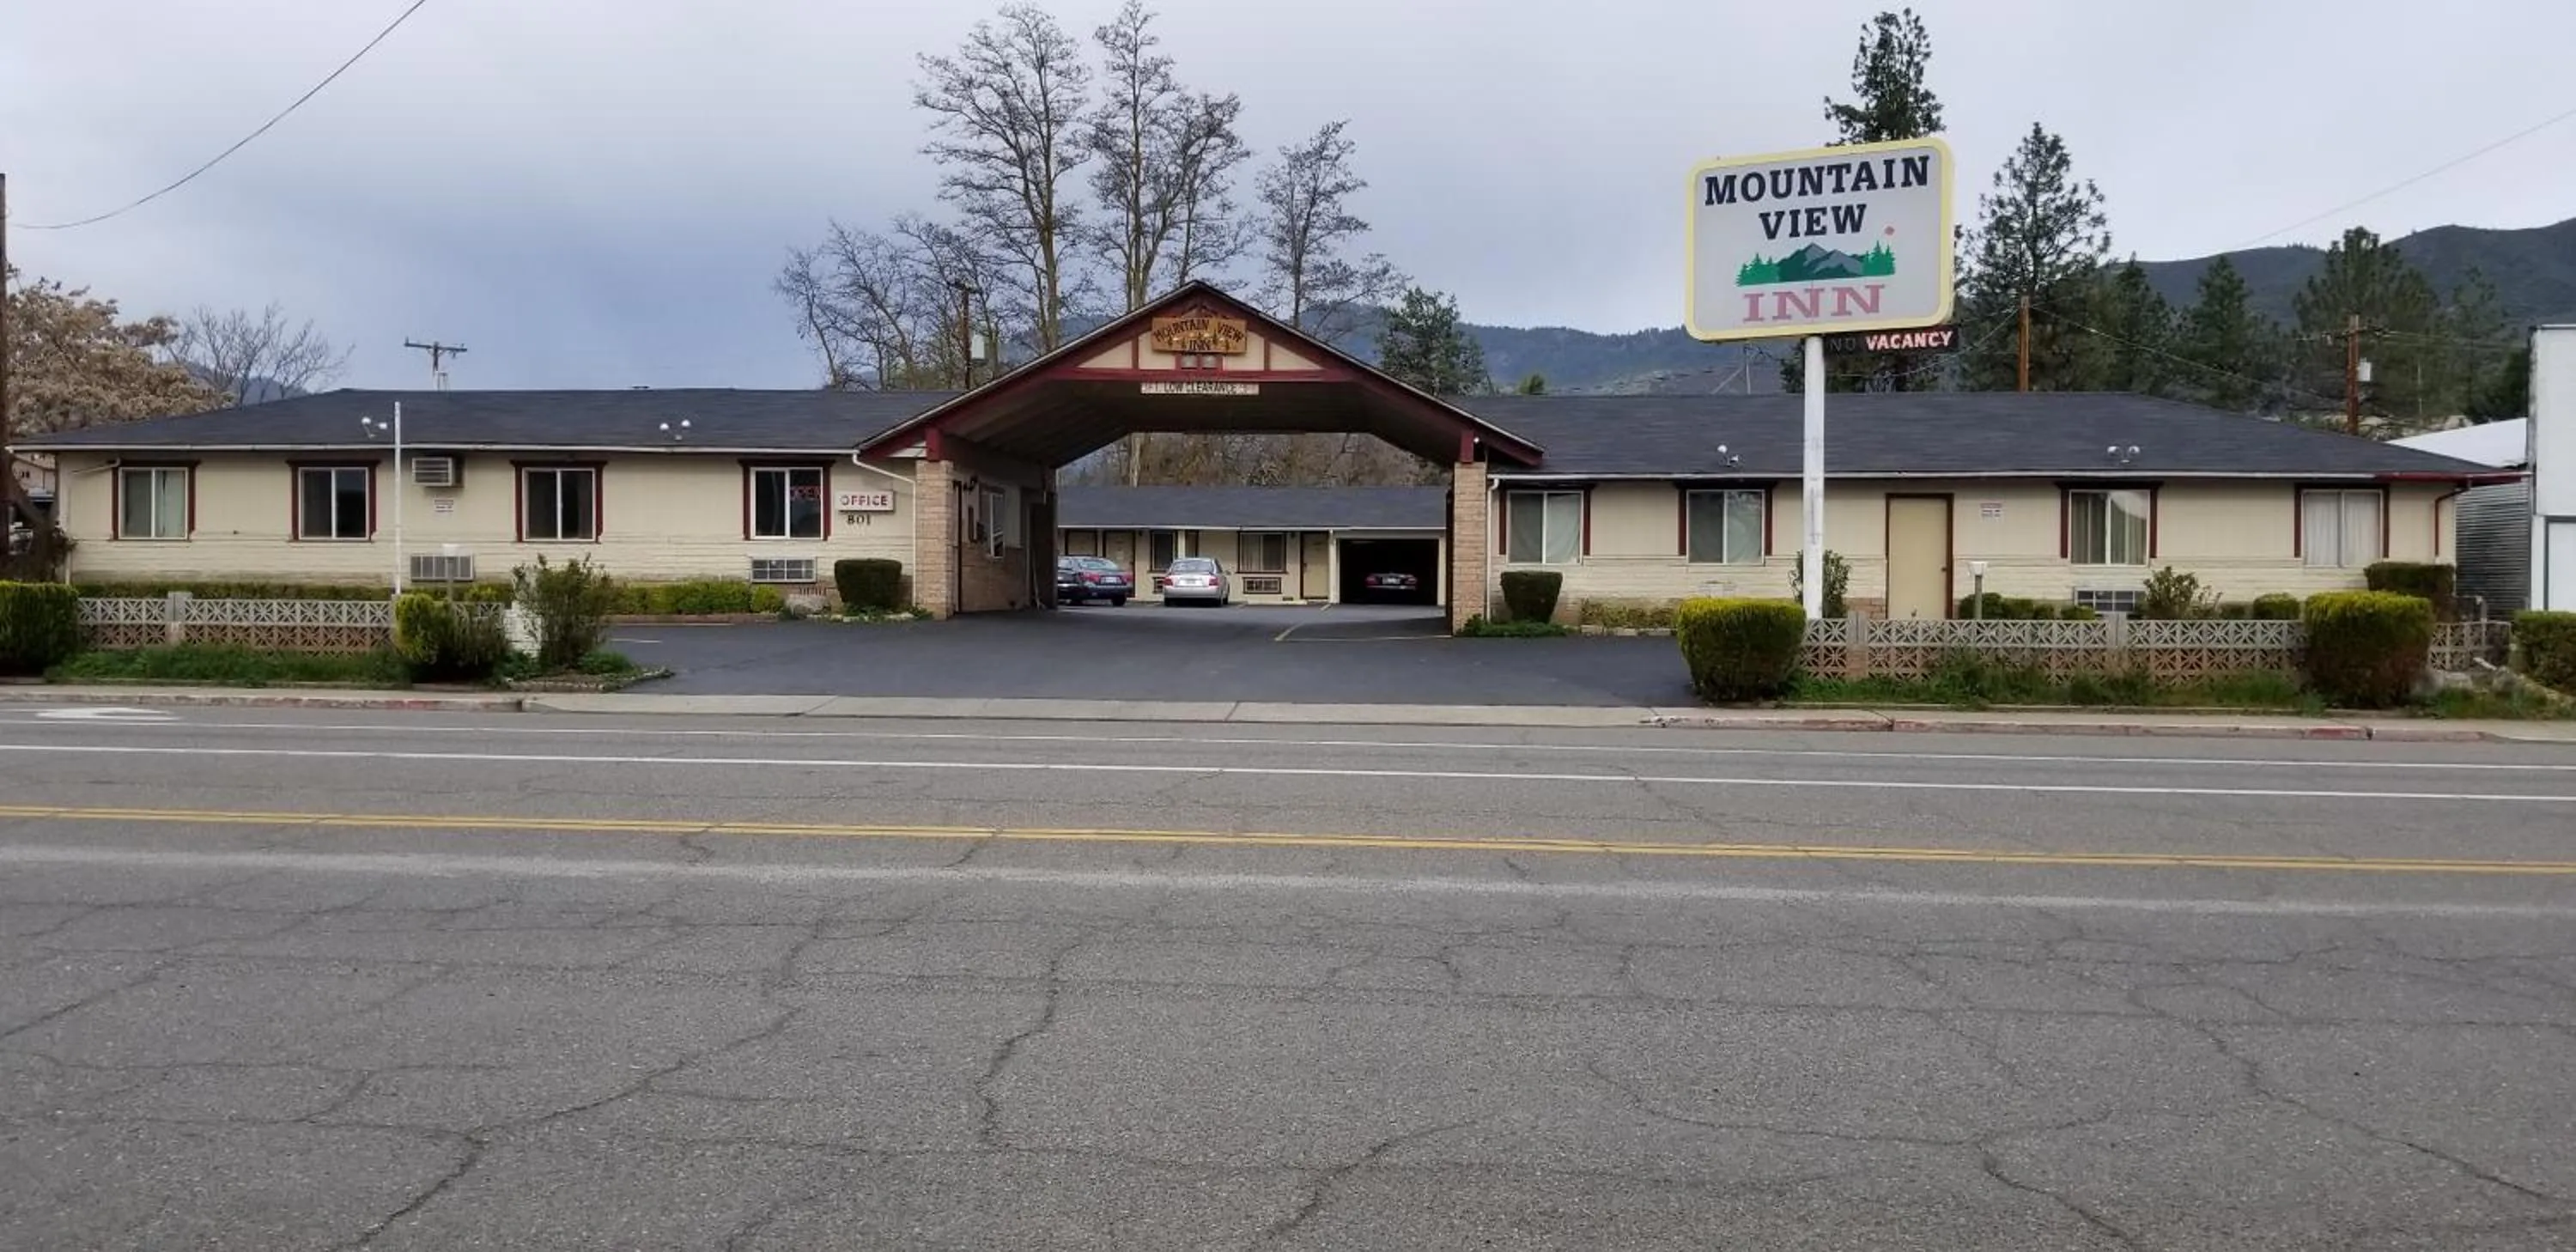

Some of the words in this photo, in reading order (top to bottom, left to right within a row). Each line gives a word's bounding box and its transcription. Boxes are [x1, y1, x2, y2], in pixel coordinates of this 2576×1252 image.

[1704, 155, 1929, 206] MOUNTAIN
[1759, 204, 1867, 240] VIEW
[1742, 283, 1886, 323] INN
[1153, 319, 1210, 342] MOUNTAIN
[1218, 322, 1245, 343] VIEW
[1830, 337, 1856, 352] NO
[1864, 331, 1953, 351] VACANCY
[1188, 339, 1211, 351] INN
[840, 494, 889, 506] OFFICE
[847, 514, 872, 526] 801
